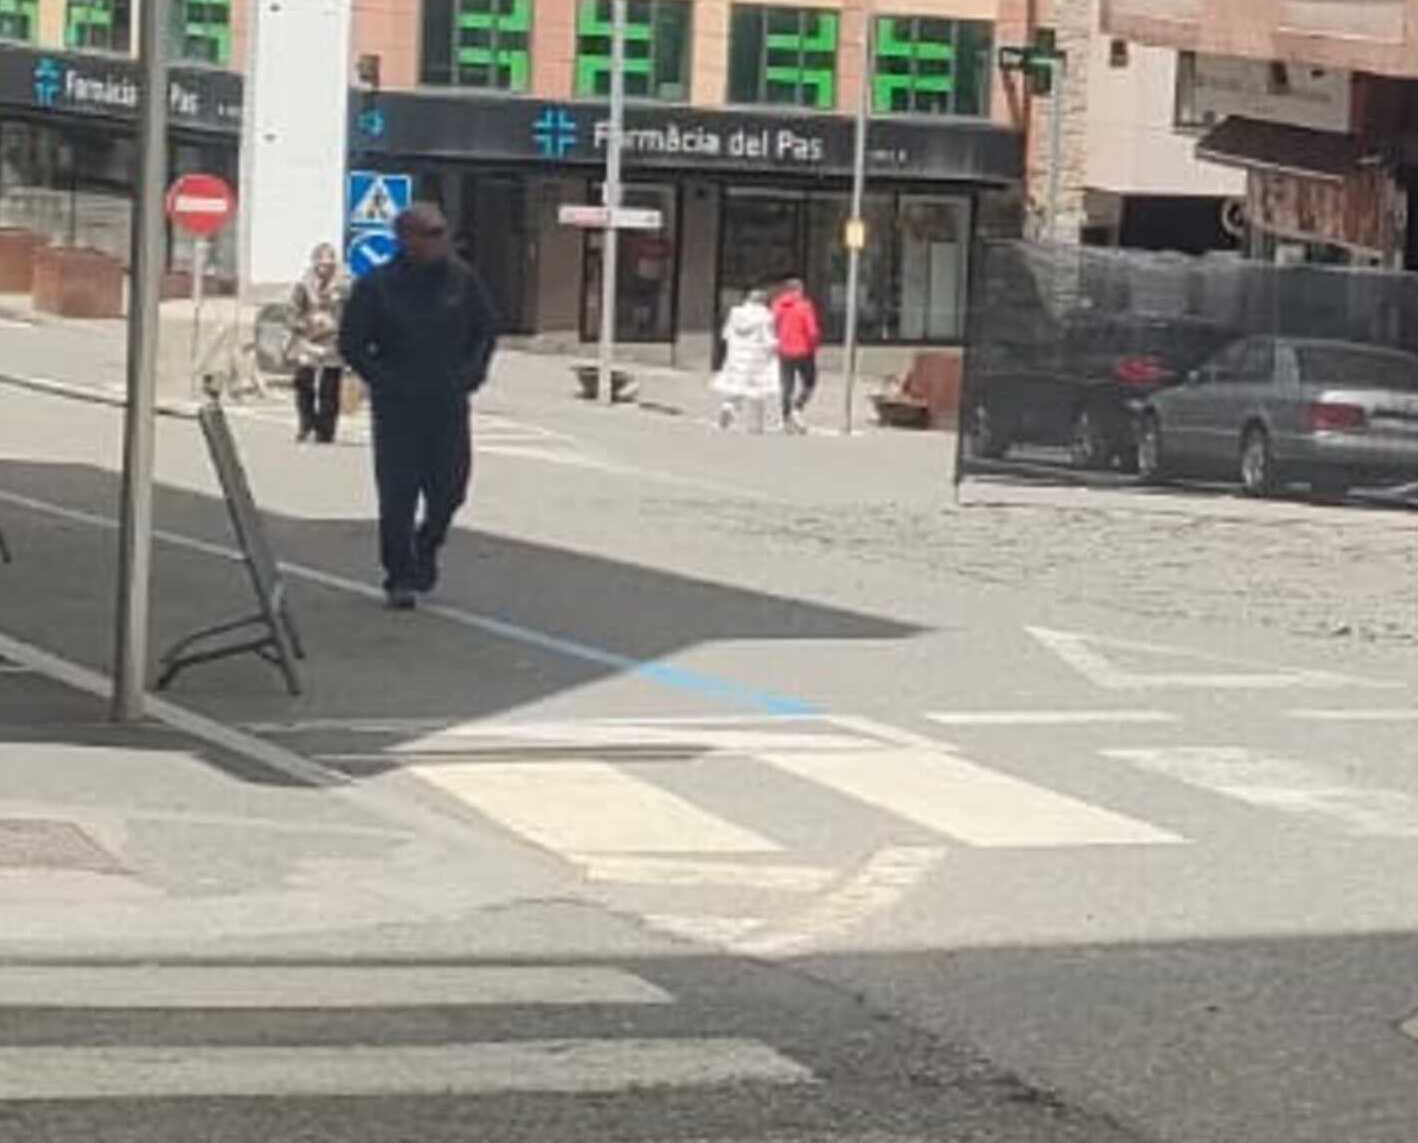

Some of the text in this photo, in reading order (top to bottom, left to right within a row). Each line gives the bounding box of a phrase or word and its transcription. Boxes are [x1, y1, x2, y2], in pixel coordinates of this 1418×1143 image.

[594, 113, 824, 160] Frmàcia del Pas
